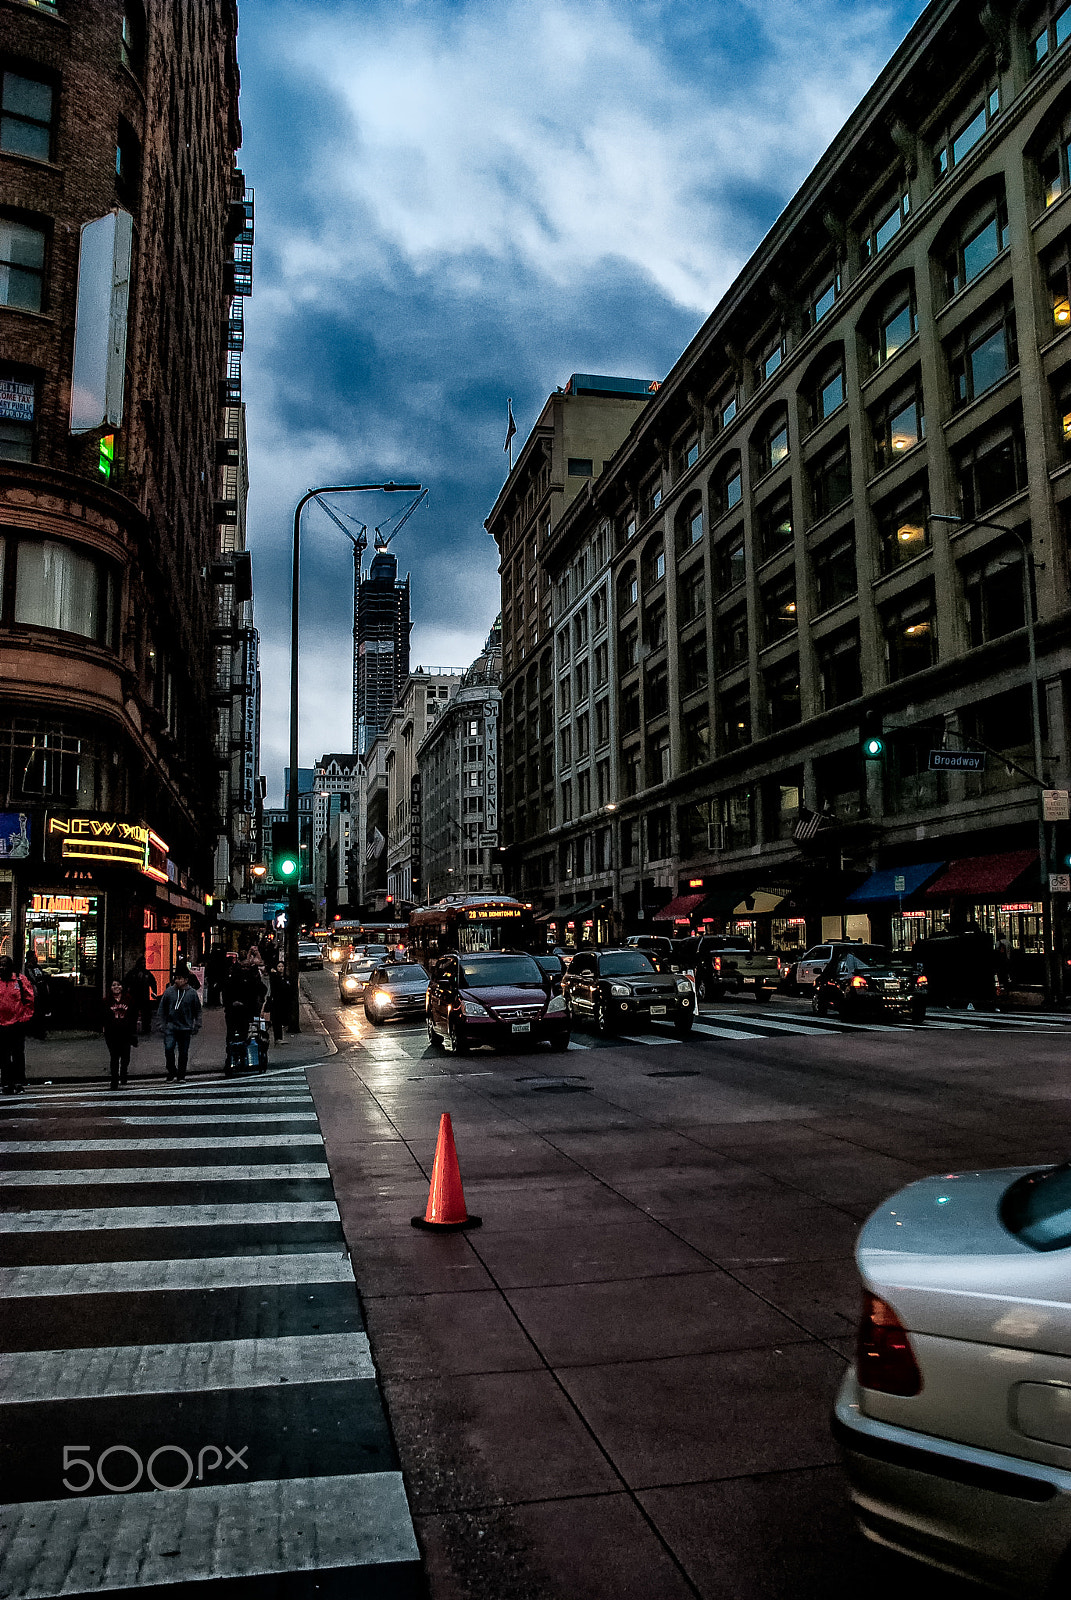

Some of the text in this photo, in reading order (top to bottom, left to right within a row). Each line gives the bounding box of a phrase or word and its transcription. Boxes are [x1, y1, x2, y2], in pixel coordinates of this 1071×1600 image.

[15, 384, 34, 396] TOURS
[18, 395, 31, 403] TAX
[12, 402, 32, 413] PUBLIC
[934, 755, 980, 769] Broadway
[487, 724, 496, 827] VINCENT
[49, 817, 116, 836] NEW
[32, 894, 90, 915] DIAMONDS
